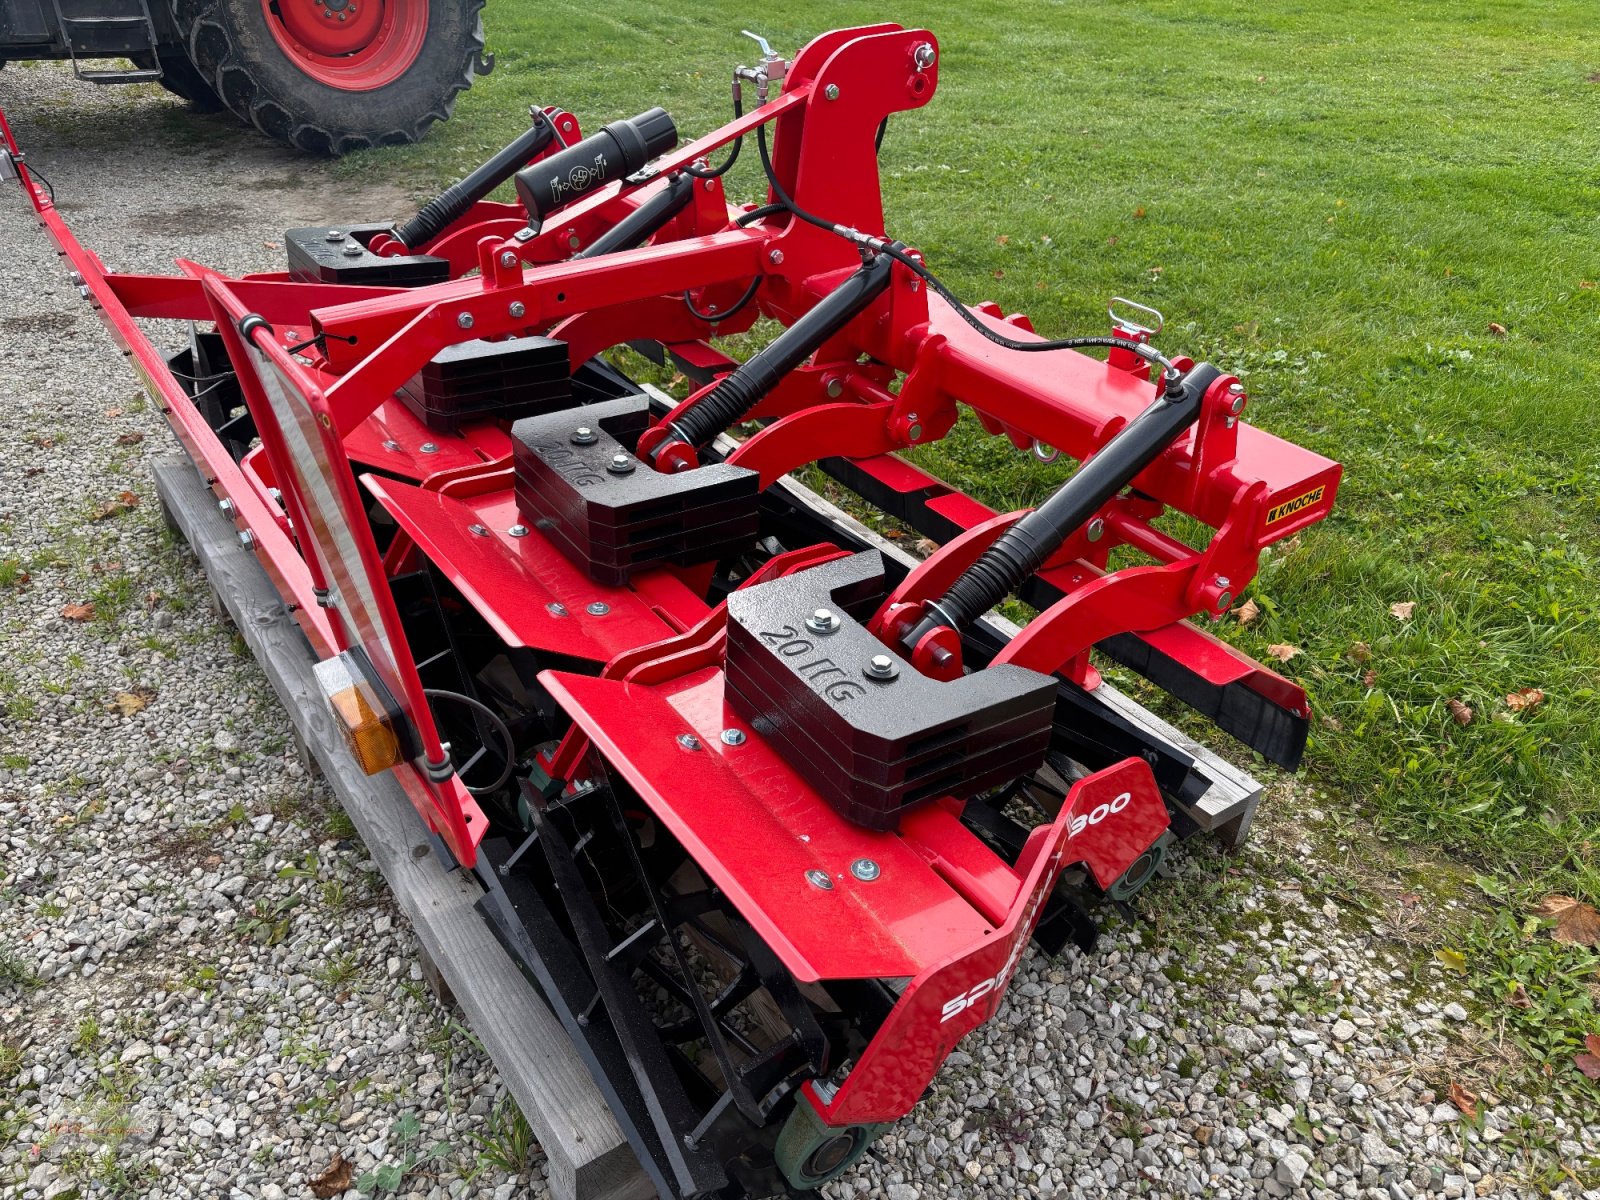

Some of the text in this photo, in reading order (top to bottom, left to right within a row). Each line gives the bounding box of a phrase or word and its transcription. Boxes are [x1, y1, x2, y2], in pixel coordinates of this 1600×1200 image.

[1278, 487, 1323, 518] KNOCHE
[759, 625, 814, 656] 20
[1068, 792, 1131, 840] 300
